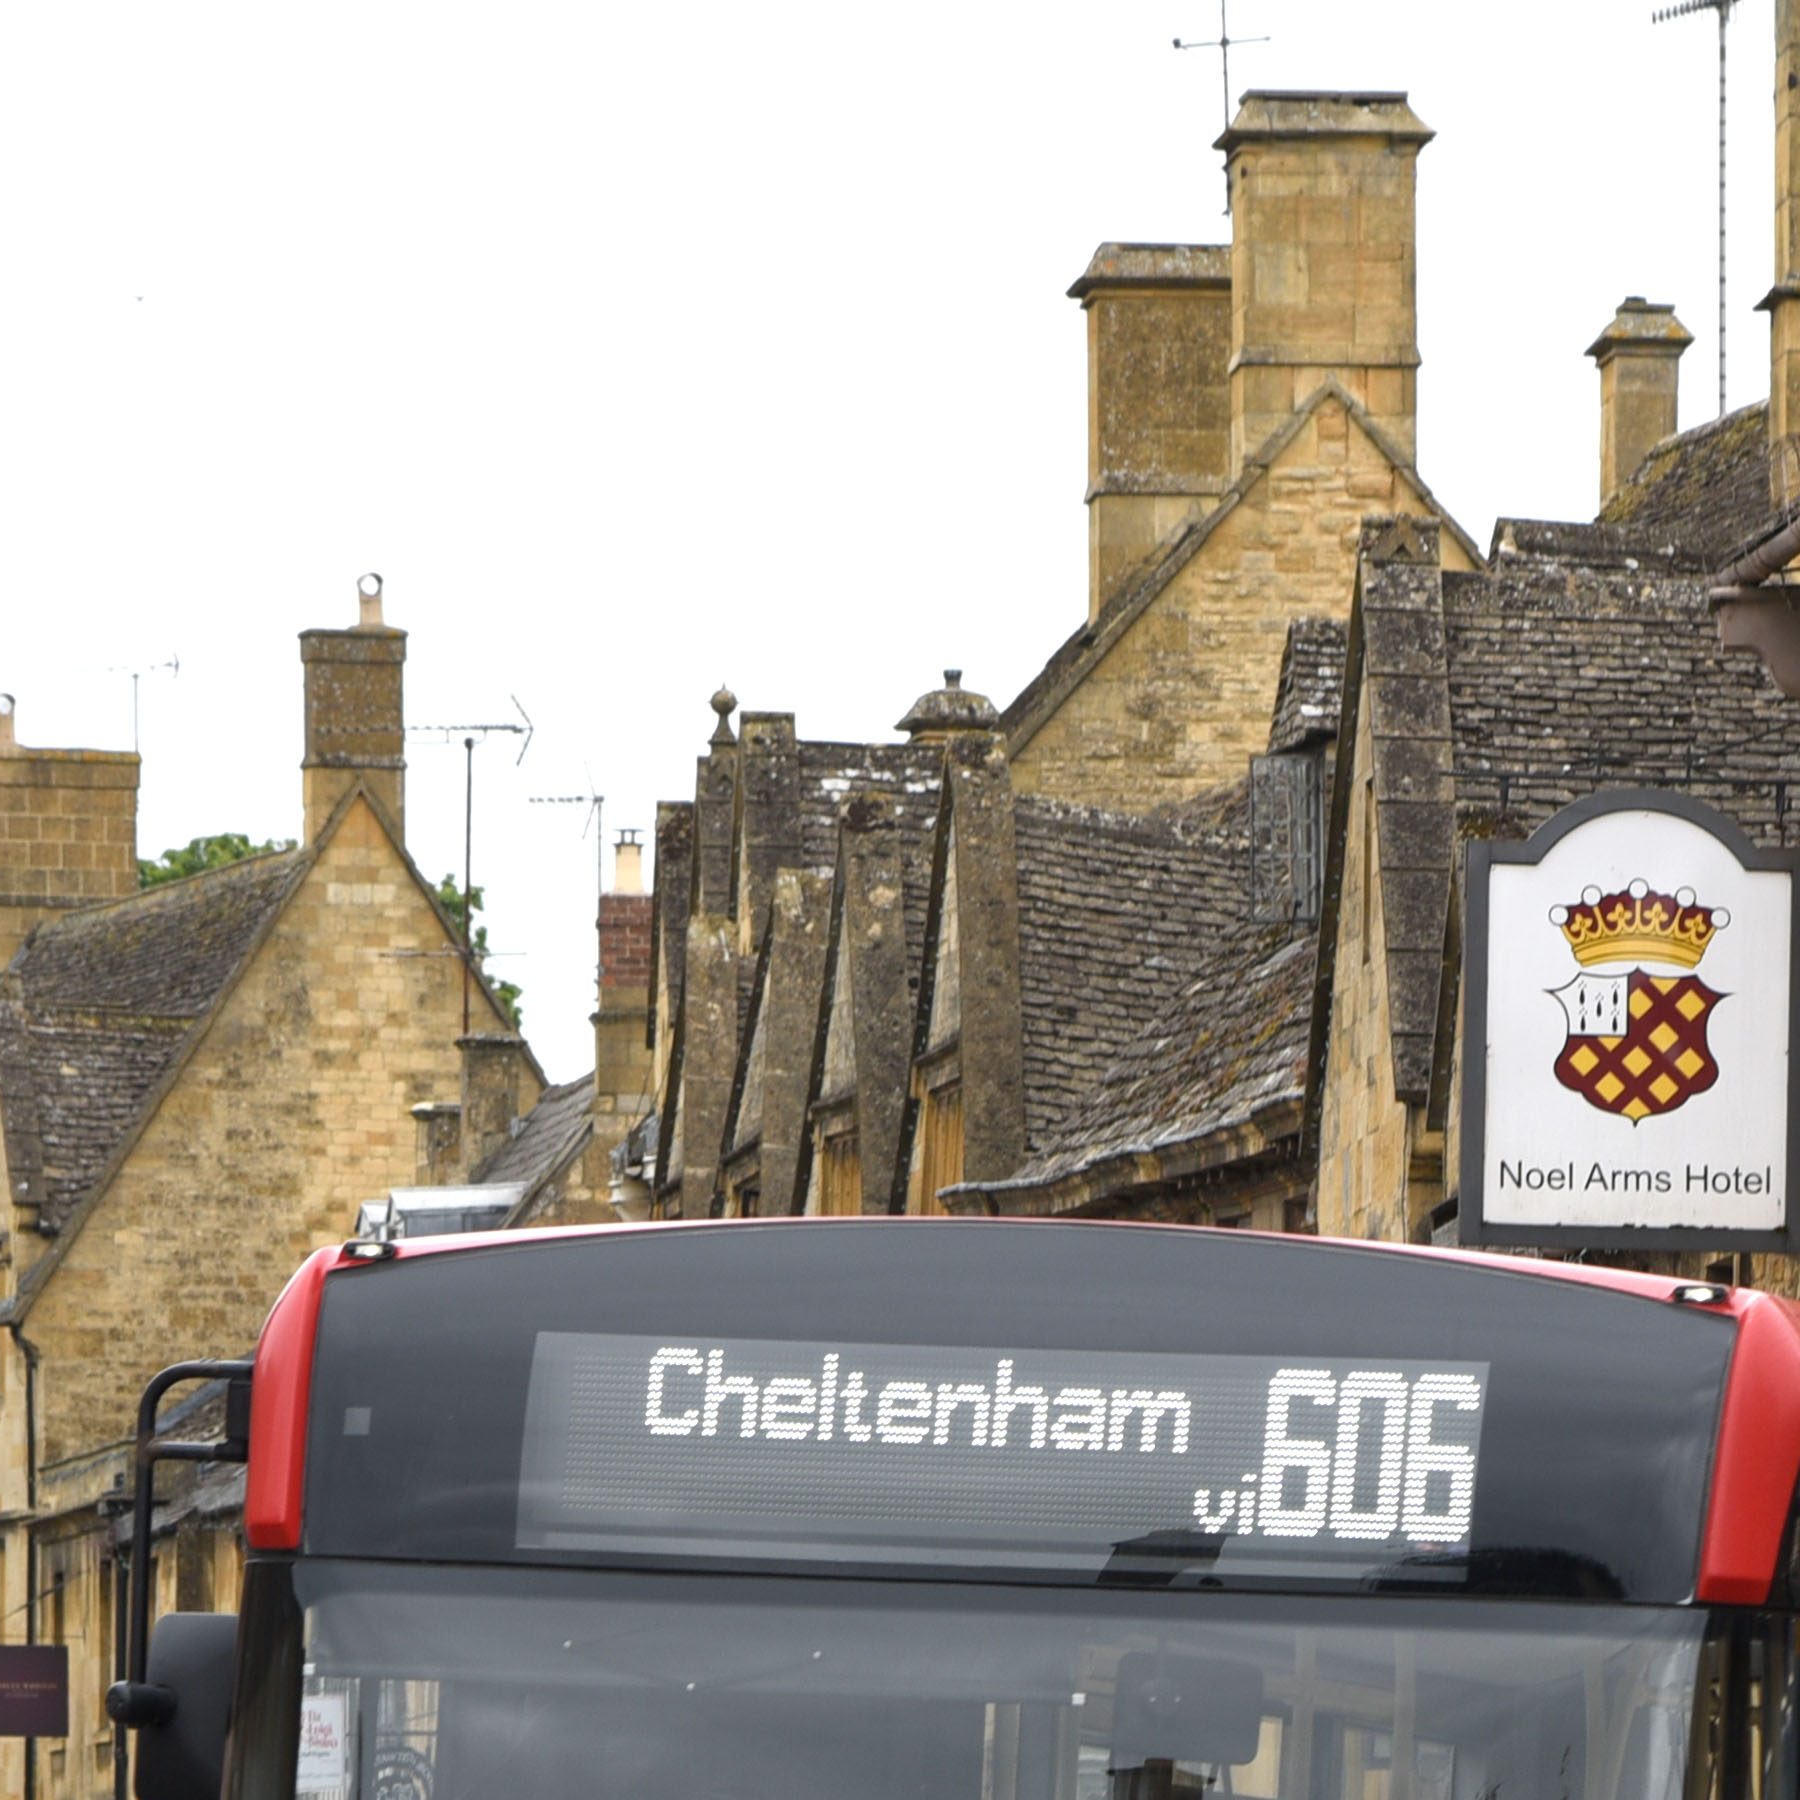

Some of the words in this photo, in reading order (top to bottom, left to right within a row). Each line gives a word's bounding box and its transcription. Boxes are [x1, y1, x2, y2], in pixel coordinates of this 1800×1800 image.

[1499, 1160, 1574, 1190] Noel
[1584, 1162, 1672, 1193] Arms
[1685, 1164, 1771, 1195] Hotel
[643, 1345, 1193, 1455] Cheltenham
[1260, 1366, 1483, 1544] 606
